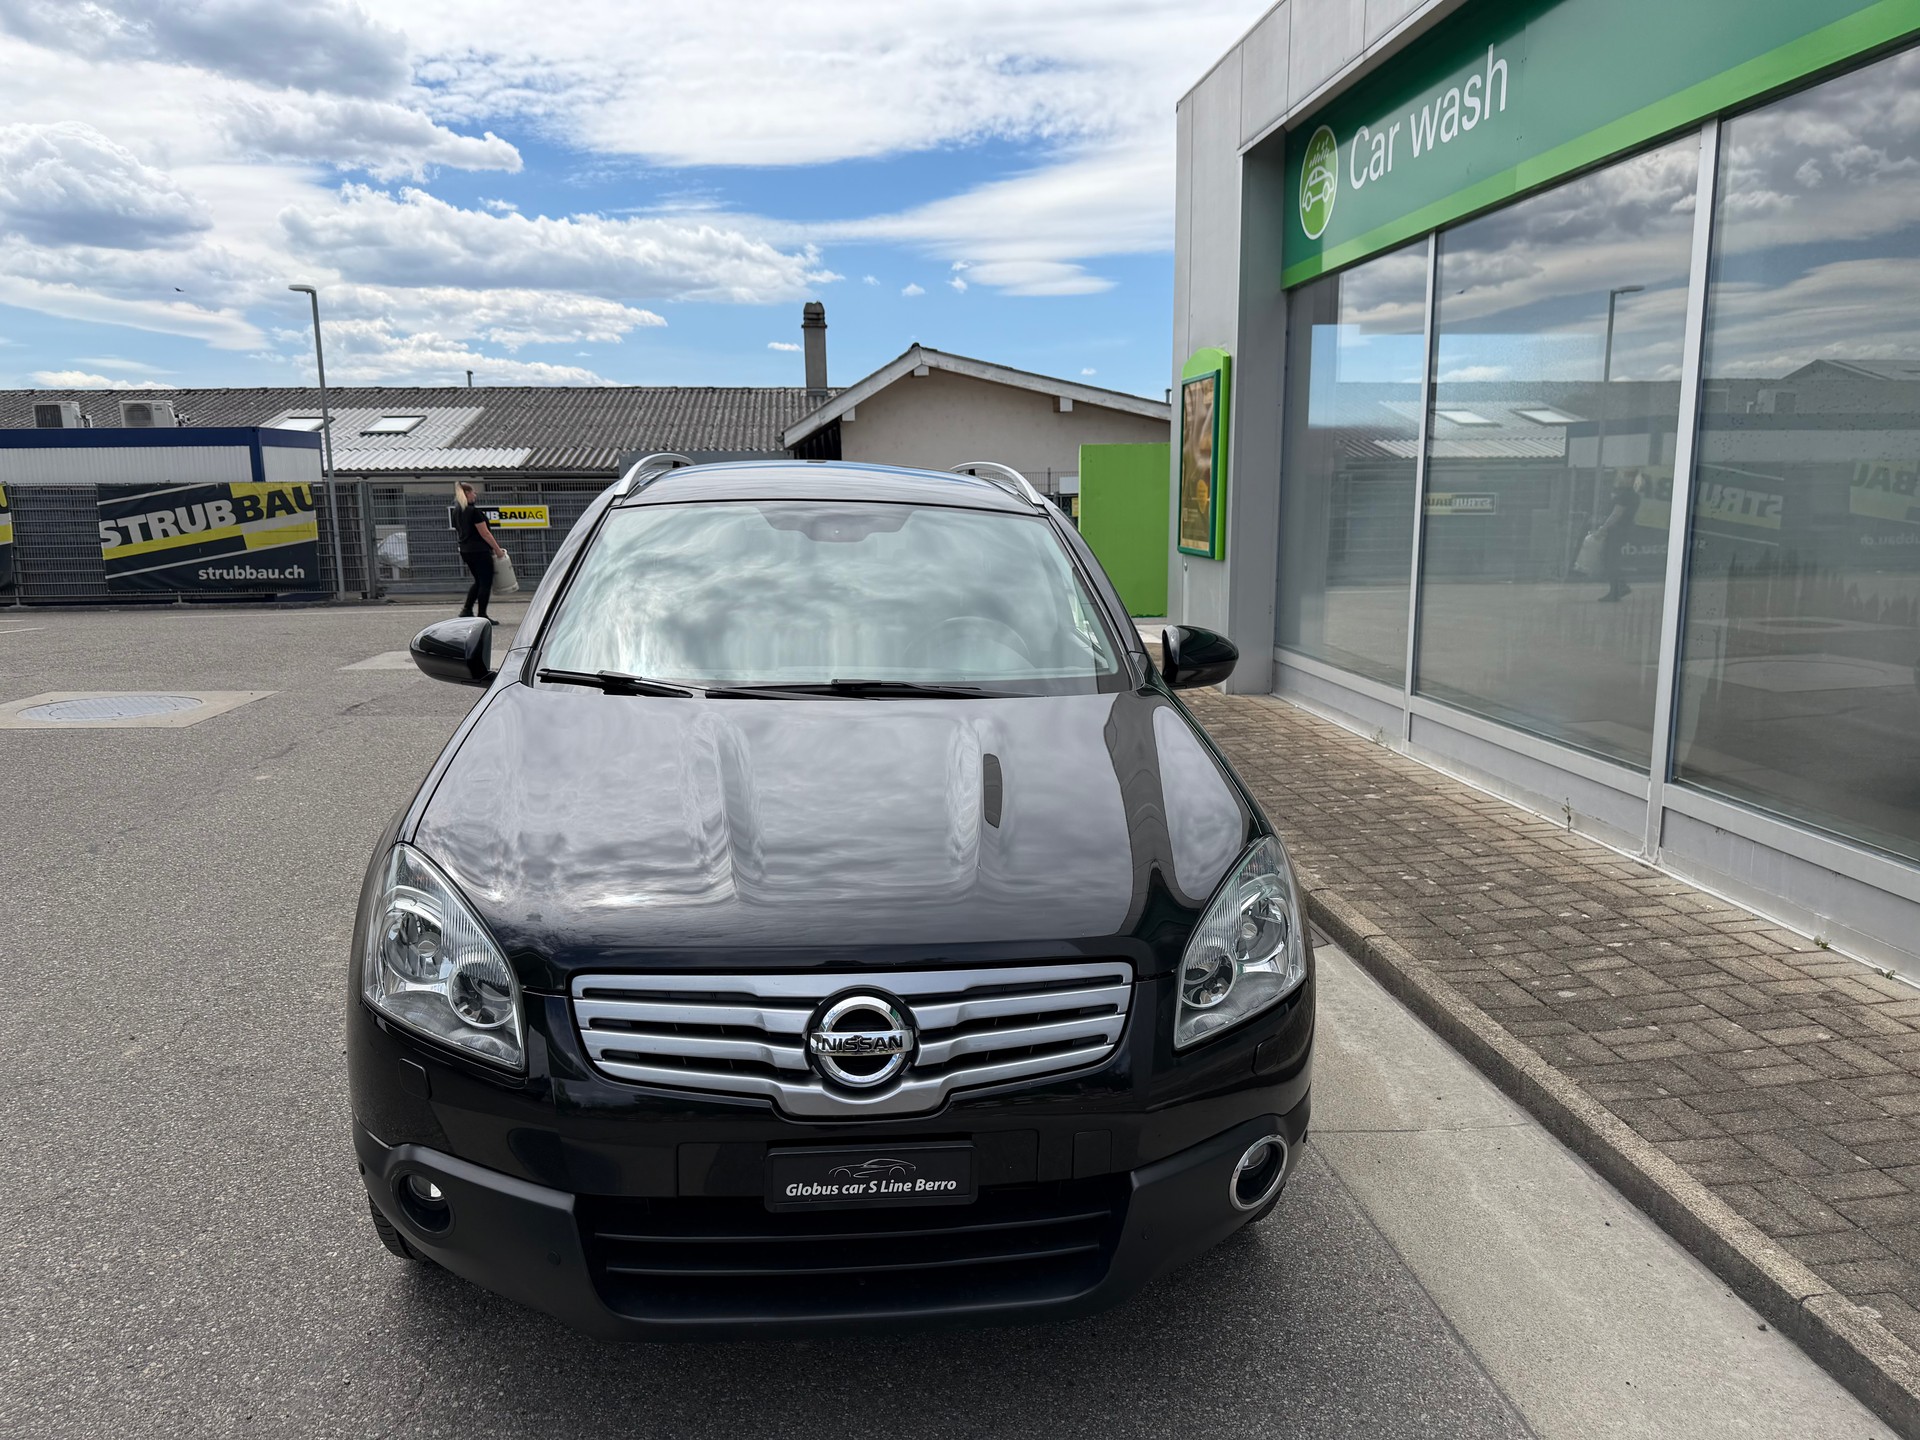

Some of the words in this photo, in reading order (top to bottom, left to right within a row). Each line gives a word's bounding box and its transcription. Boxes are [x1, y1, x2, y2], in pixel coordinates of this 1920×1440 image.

[1349, 120, 1400, 189] Car
[1410, 43, 1508, 159] wash
[99, 484, 314, 548] STRUBBAU
[198, 565, 305, 580] strubbau.ch
[821, 1034, 904, 1051] NISSAN
[786, 1182, 839, 1197] Globus
[842, 1182, 865, 1194] car
[869, 1181, 877, 1193] S
[881, 1179, 912, 1193] Line
[915, 1178, 957, 1192] Berro
